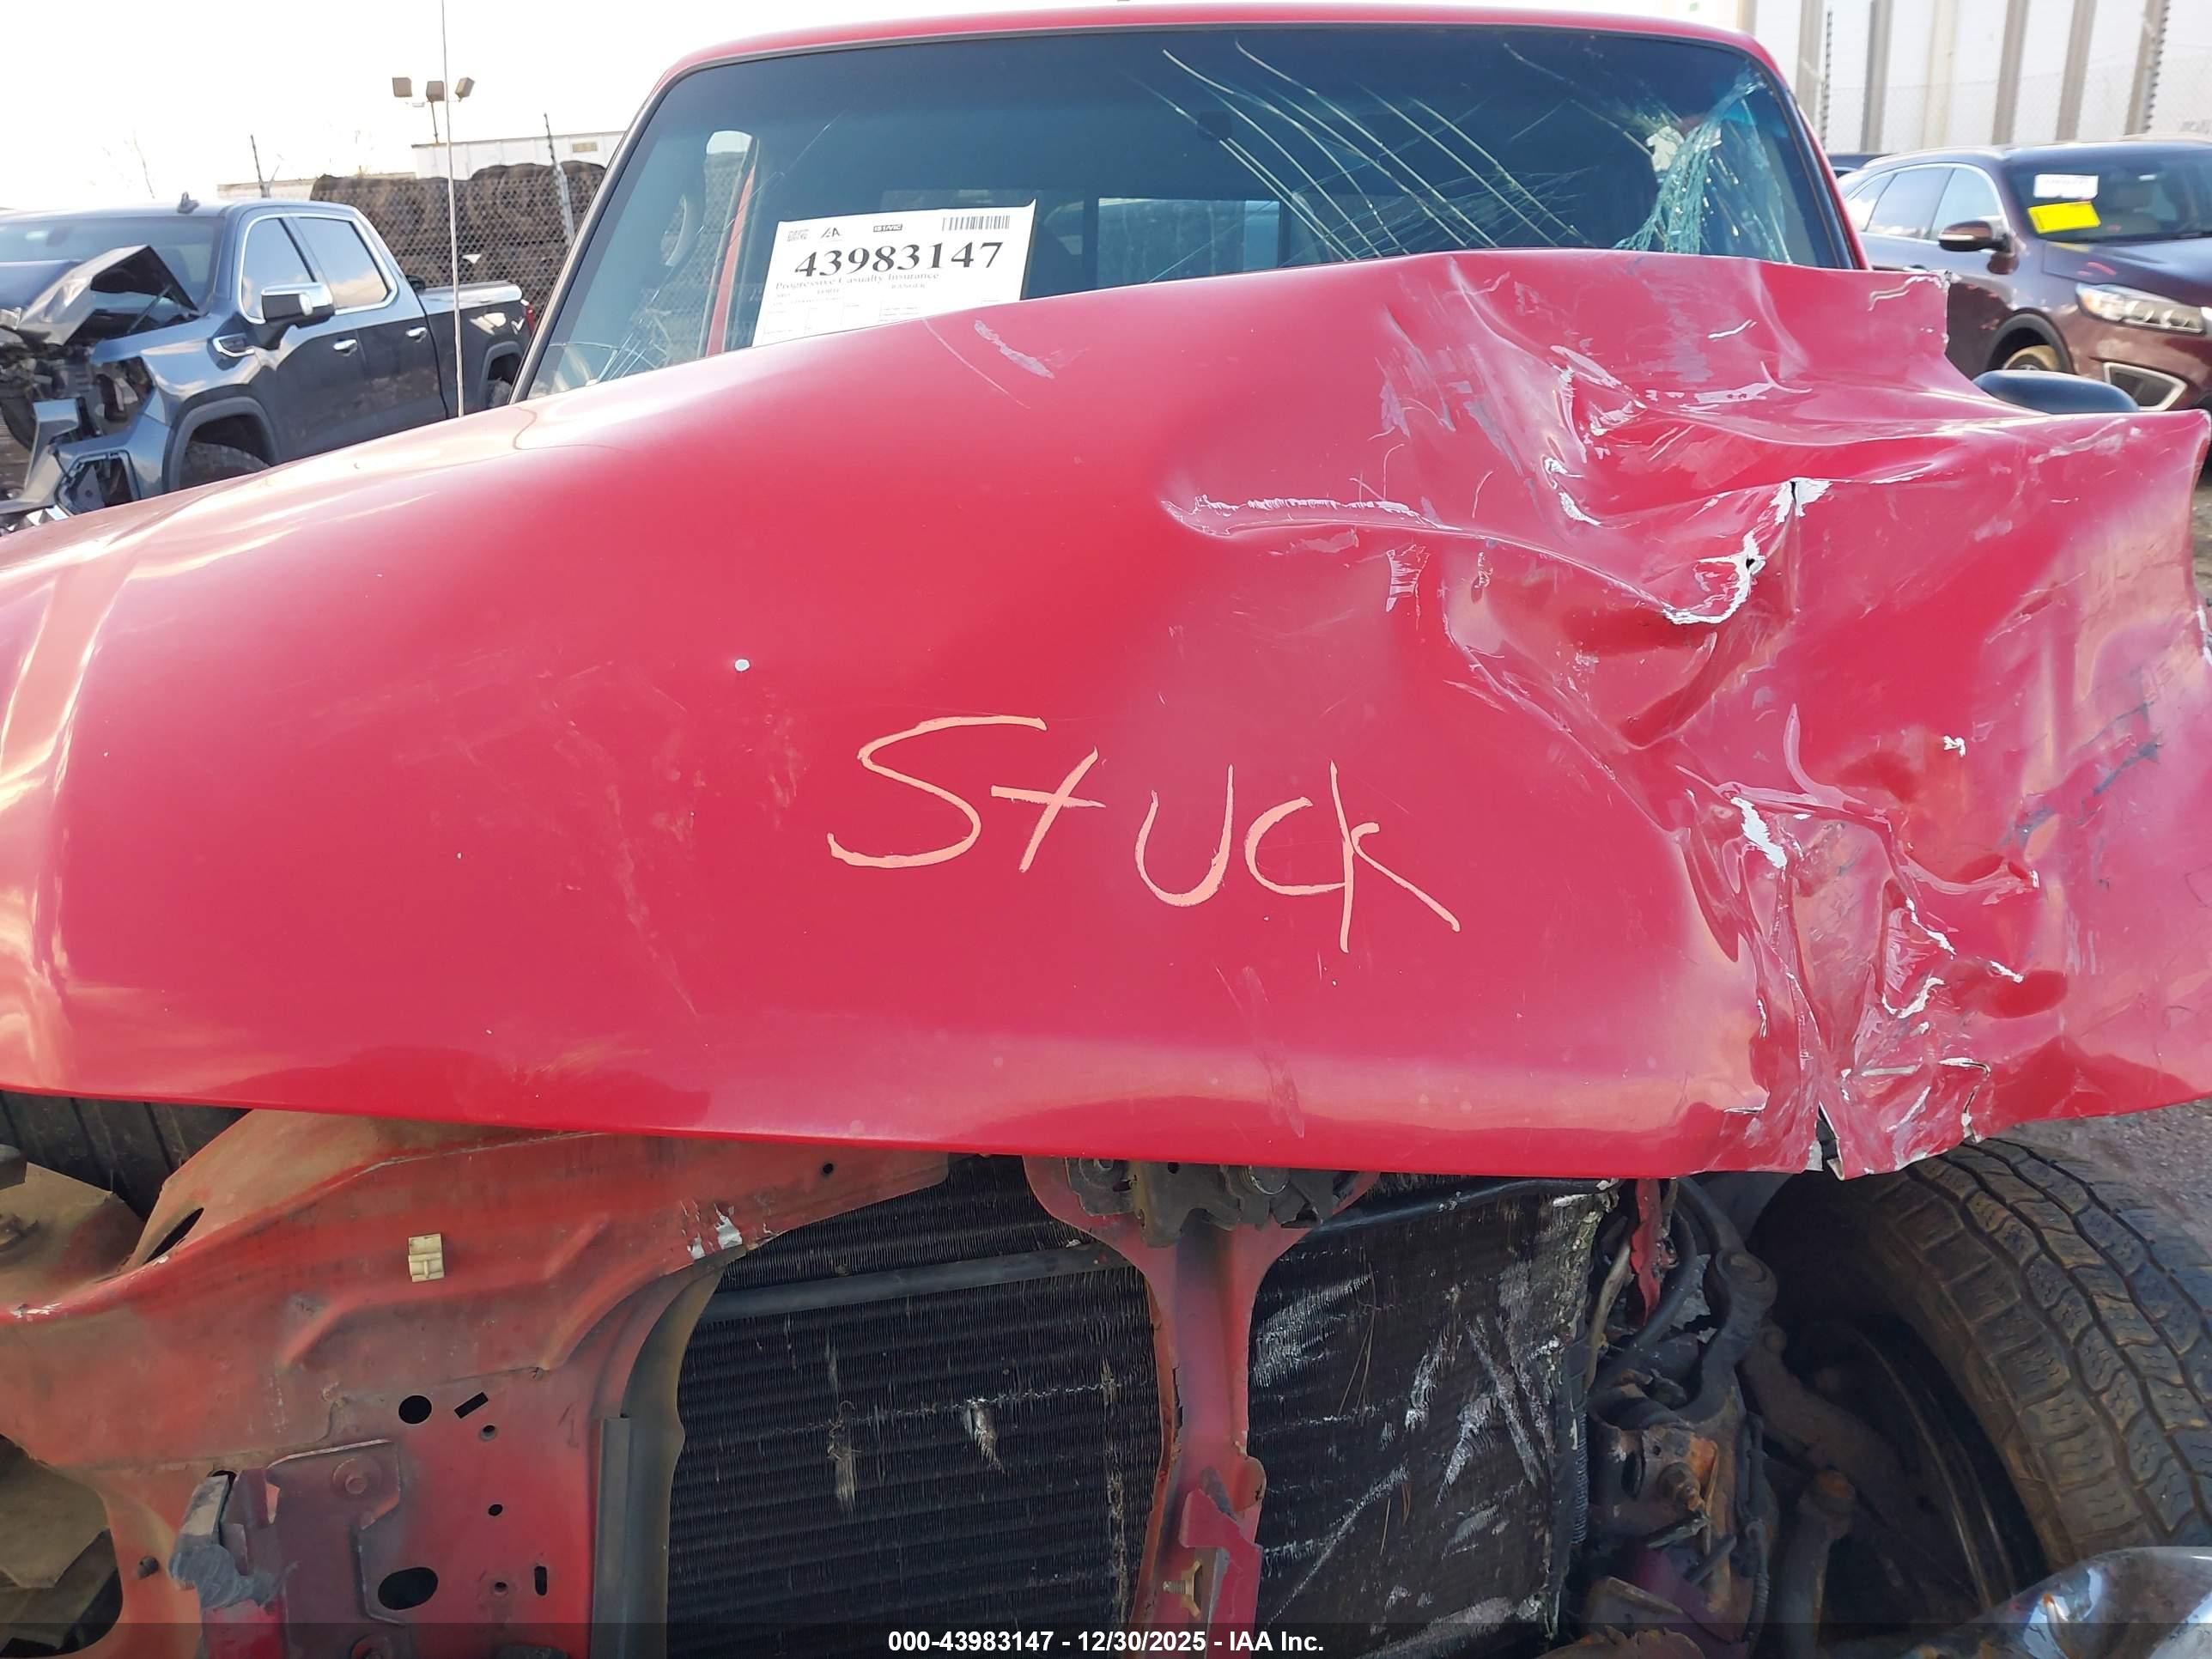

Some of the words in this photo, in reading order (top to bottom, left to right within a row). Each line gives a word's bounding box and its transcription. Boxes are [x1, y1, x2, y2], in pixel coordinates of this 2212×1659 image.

[794, 241, 1004, 277] 43983147
[775, 277, 836, 290] Progressive
[838, 274, 883, 284] Casualty
[888, 271, 940, 282] Insurance
